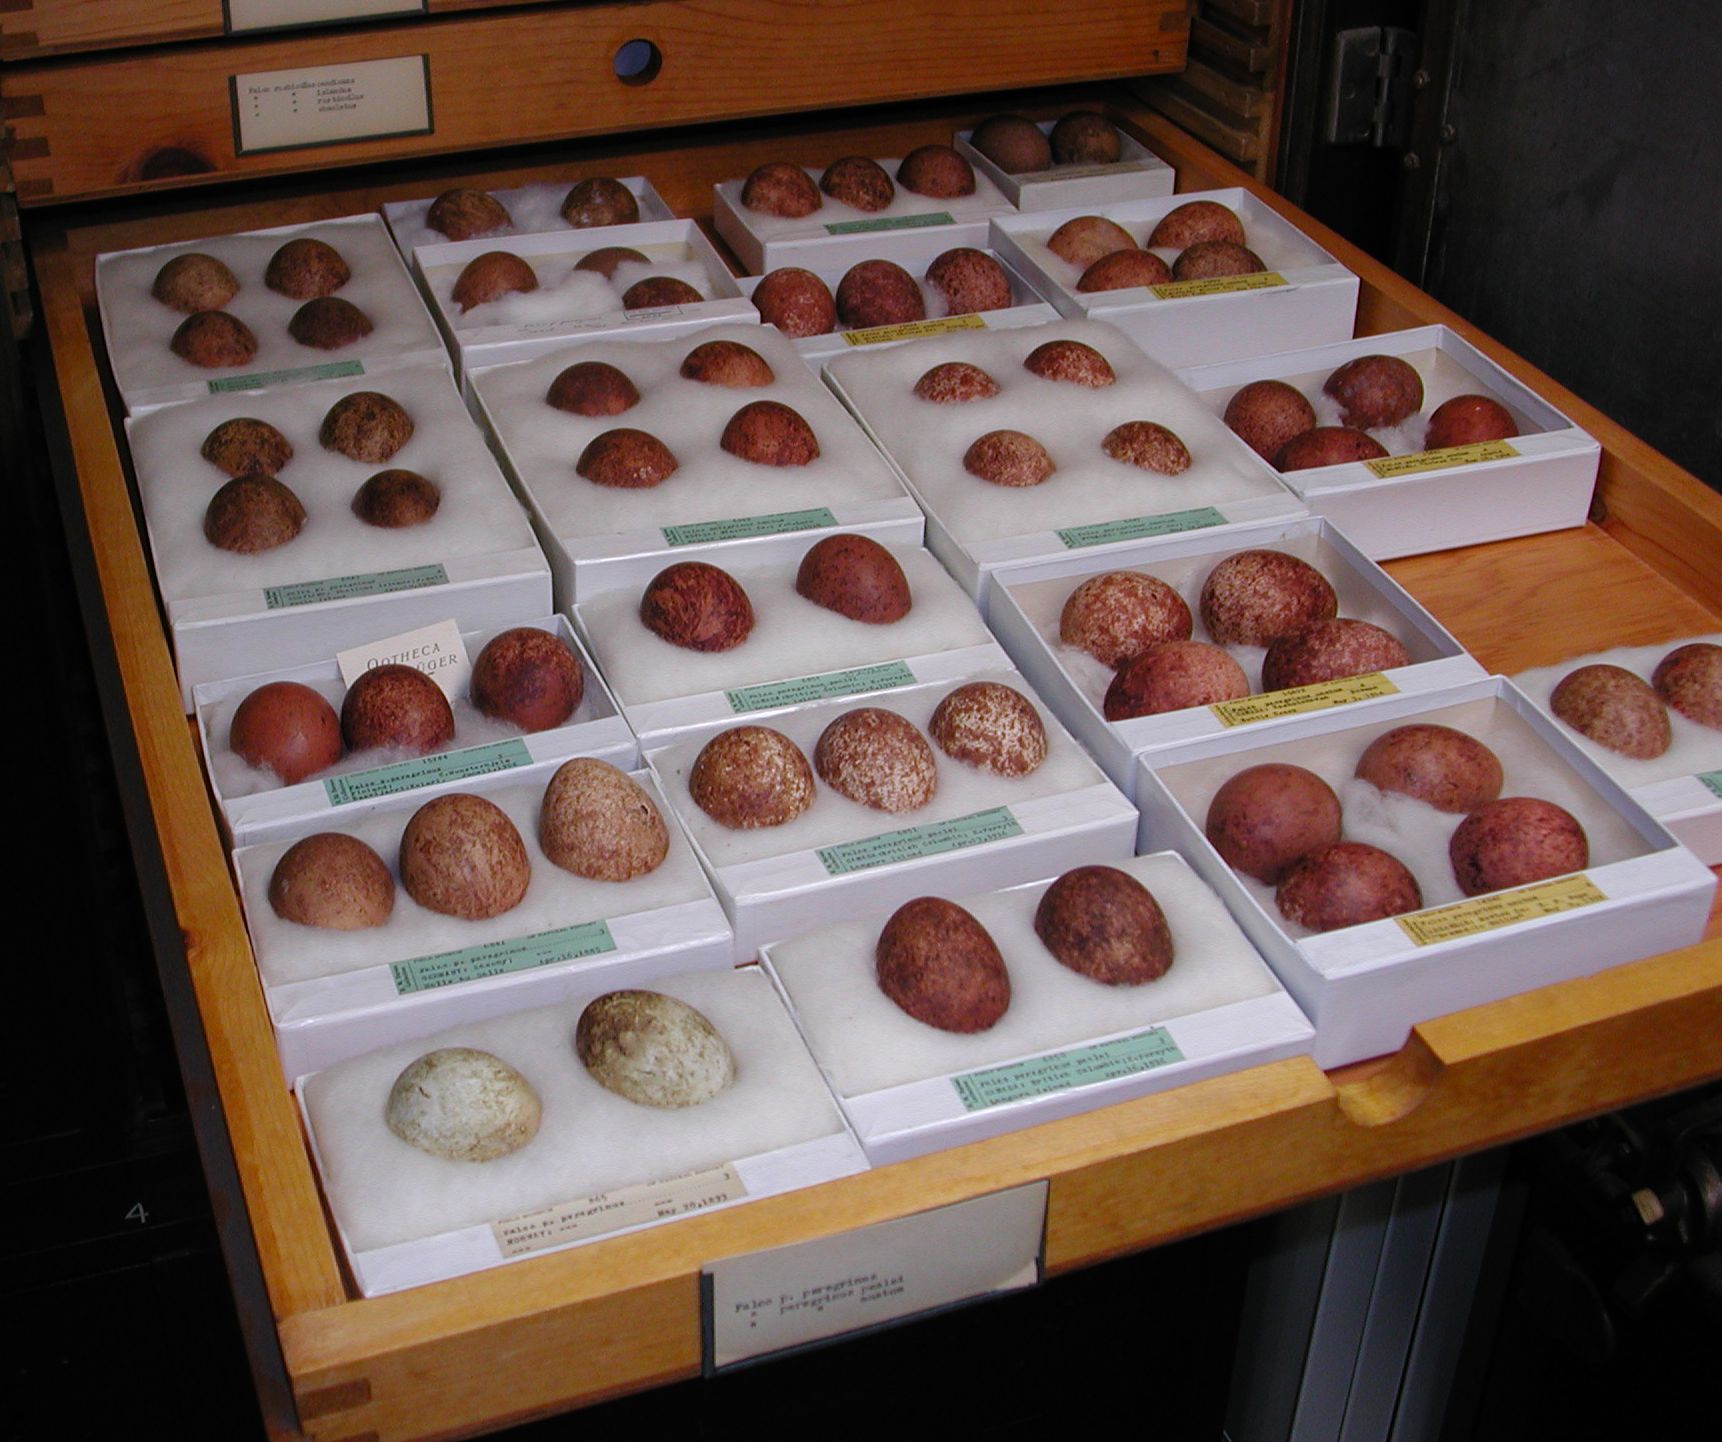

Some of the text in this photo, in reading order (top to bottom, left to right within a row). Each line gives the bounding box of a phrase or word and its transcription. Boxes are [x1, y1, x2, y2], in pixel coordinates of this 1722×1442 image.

[367, 643, 441, 670] OOTHECA
[125, 1202, 149, 1224] 4
[561, 1200, 625, 1222] peregrinus
[735, 1298, 773, 1313] Falco
[803, 1274, 877, 1299] peregrinus
